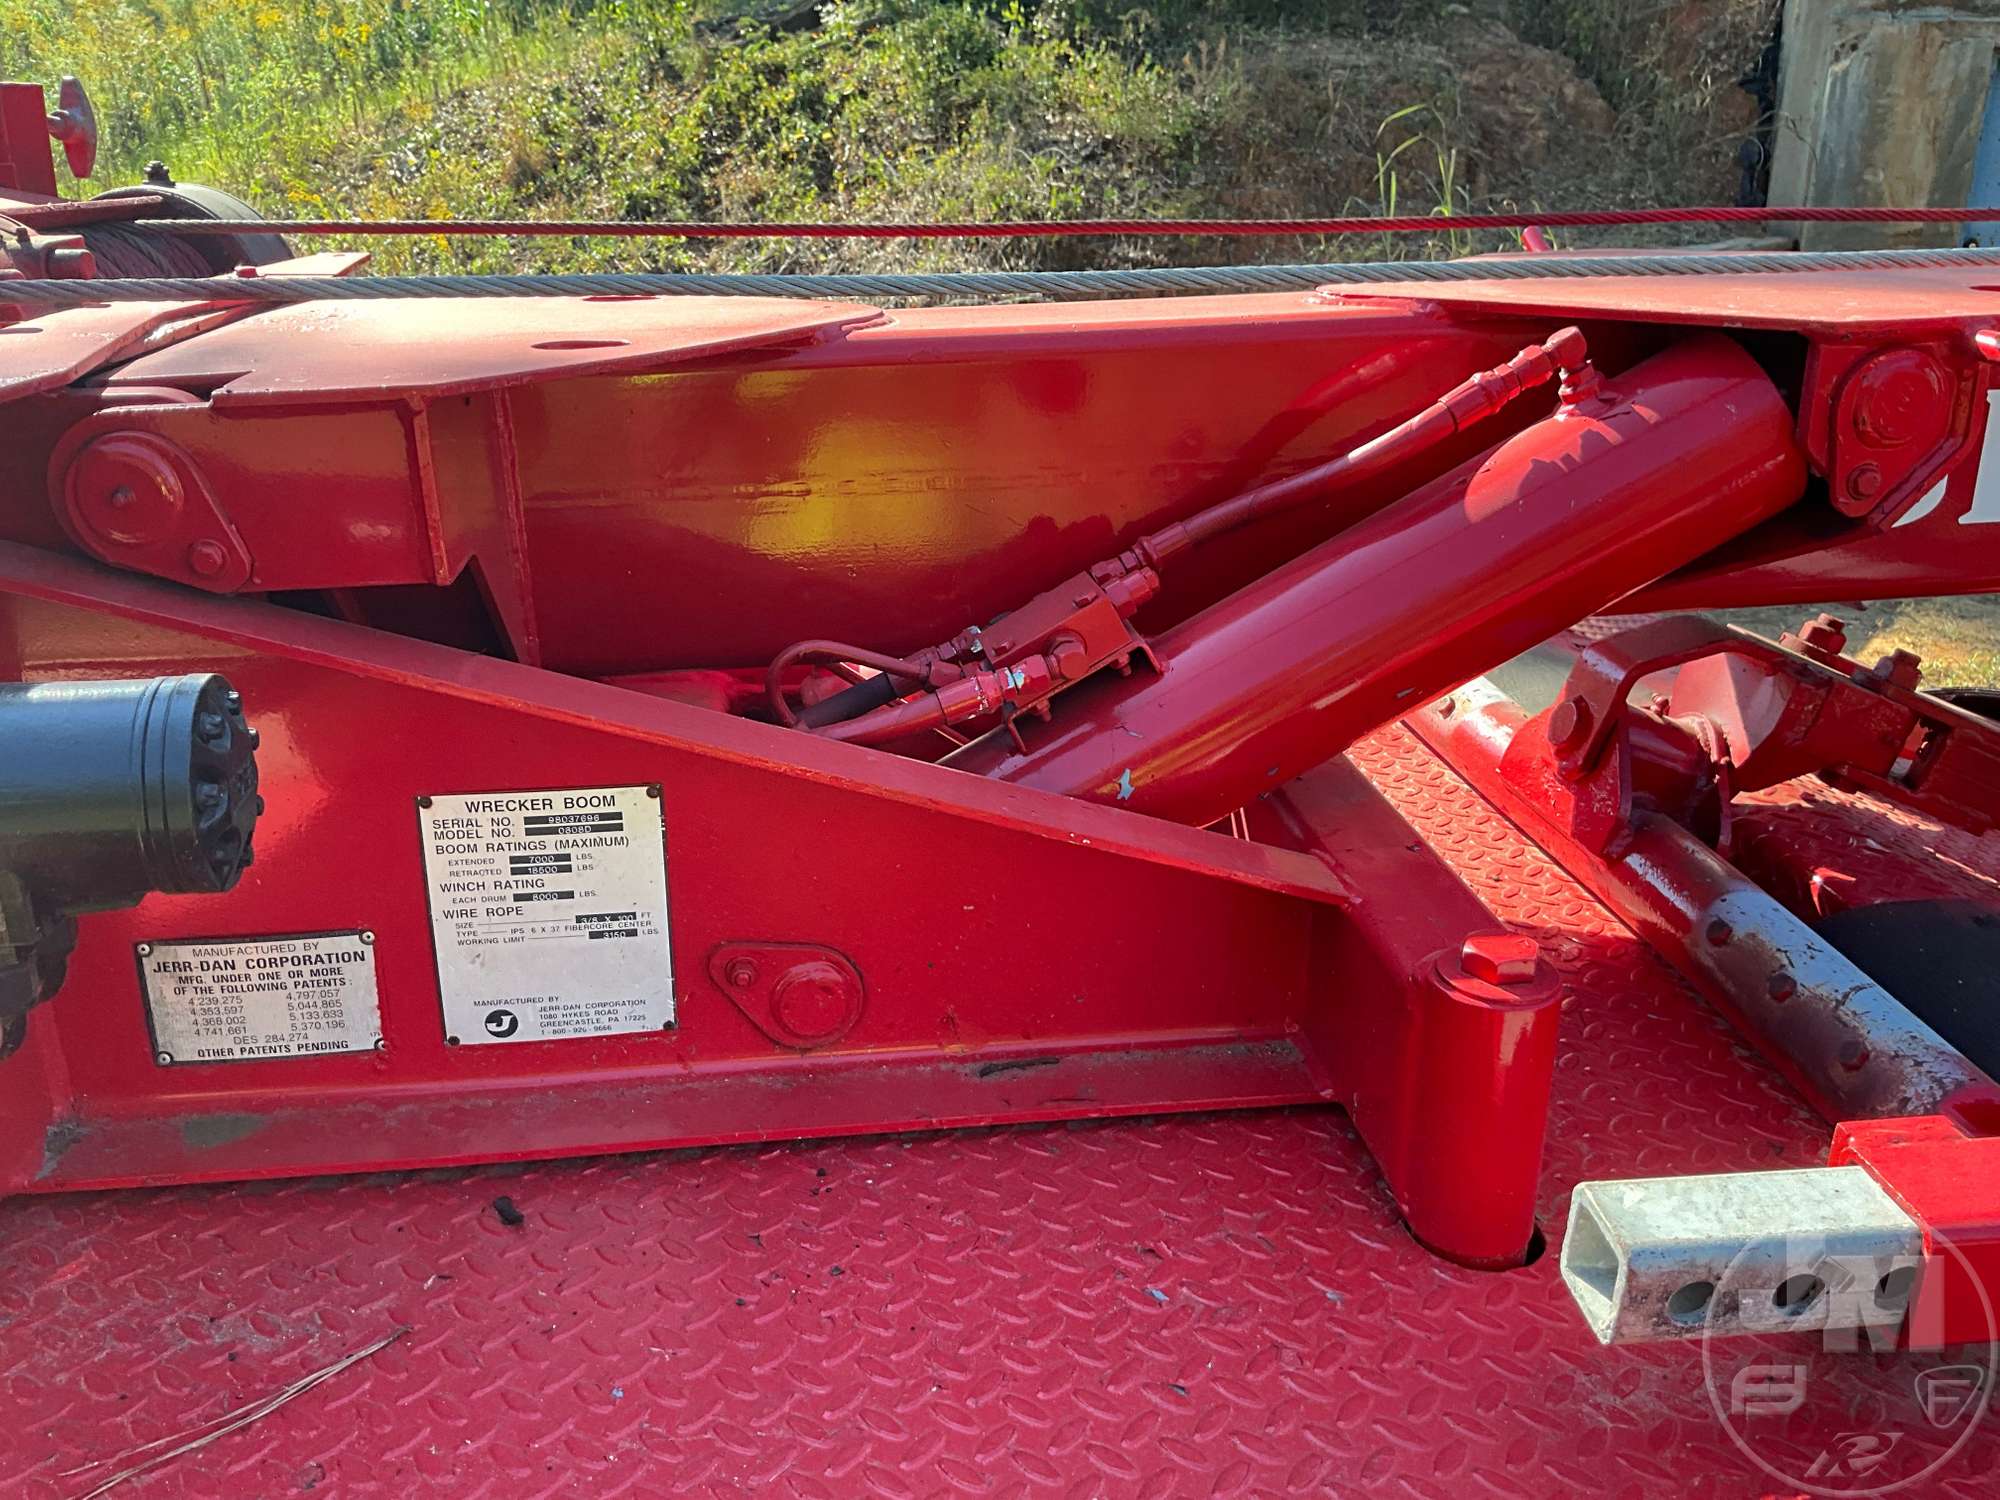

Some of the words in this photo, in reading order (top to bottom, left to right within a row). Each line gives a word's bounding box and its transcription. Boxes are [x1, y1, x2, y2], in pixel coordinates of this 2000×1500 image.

[465, 798, 553, 813] WRECKER
[564, 795, 616, 809] BOOM
[433, 818, 483, 829] SERIAL
[491, 817, 515, 827] NO.
[434, 829, 484, 840] MODEL
[491, 828, 515, 838] NO.
[436, 843, 478, 854] BOOM
[486, 840, 547, 853] RATINGS
[555, 836, 629, 850] (MAXIMUM)
[448, 858, 495, 867] EXTENDED
[528, 855, 555, 864] 7000
[576, 853, 593, 861] LBS
[449, 868, 502, 877] RETRACTED
[440, 881, 486, 893] WINCH
[494, 878, 545, 890] RATING
[481, 895, 507, 903] DRUM
[579, 890, 597, 898] LBS
[443, 908, 478, 919] WIRE
[486, 906, 524, 917] ROPE
[455, 922, 474, 930] SIZE
[456, 930, 478, 938] TYPE
[510, 927, 525, 935] IPS
[550, 925, 560, 933] 37
[565, 922, 613, 932] FIBERCORE
[618, 920, 652, 929] CENTER
[457, 937, 499, 946] WORKING
[503, 936, 526, 944] LIMIT
[642, 928, 659, 936] LBS
[193, 944, 297, 957] MANUFACTURED
[303, 942, 319, 951] BY
[153, 959, 237, 973] JERR-DAN
[245, 950, 366, 969] CORPORATION
[179, 975, 206, 985] MFG.
[212, 973, 252, 984] UNDER
[258, 971, 282, 981] ONE
[288, 970, 304, 979] OR
[310, 967, 344, 977] MORE
[173, 986, 188, 996] OF
[193, 985, 215, 995] THE
[221, 981, 288, 994] FOLLOWING
[474, 997, 544, 1006] MANUFACTURED
[585, 999, 647, 1010] CORPORATION
[562, 1011, 591, 1019] HYKES
[594, 1009, 619, 1017] ROAD
[233, 1035, 259, 1045] DES
[197, 1047, 235, 1058] OTHER
[240, 1044, 291, 1055] PATENTS
[297, 1040, 349, 1052] PENDING
